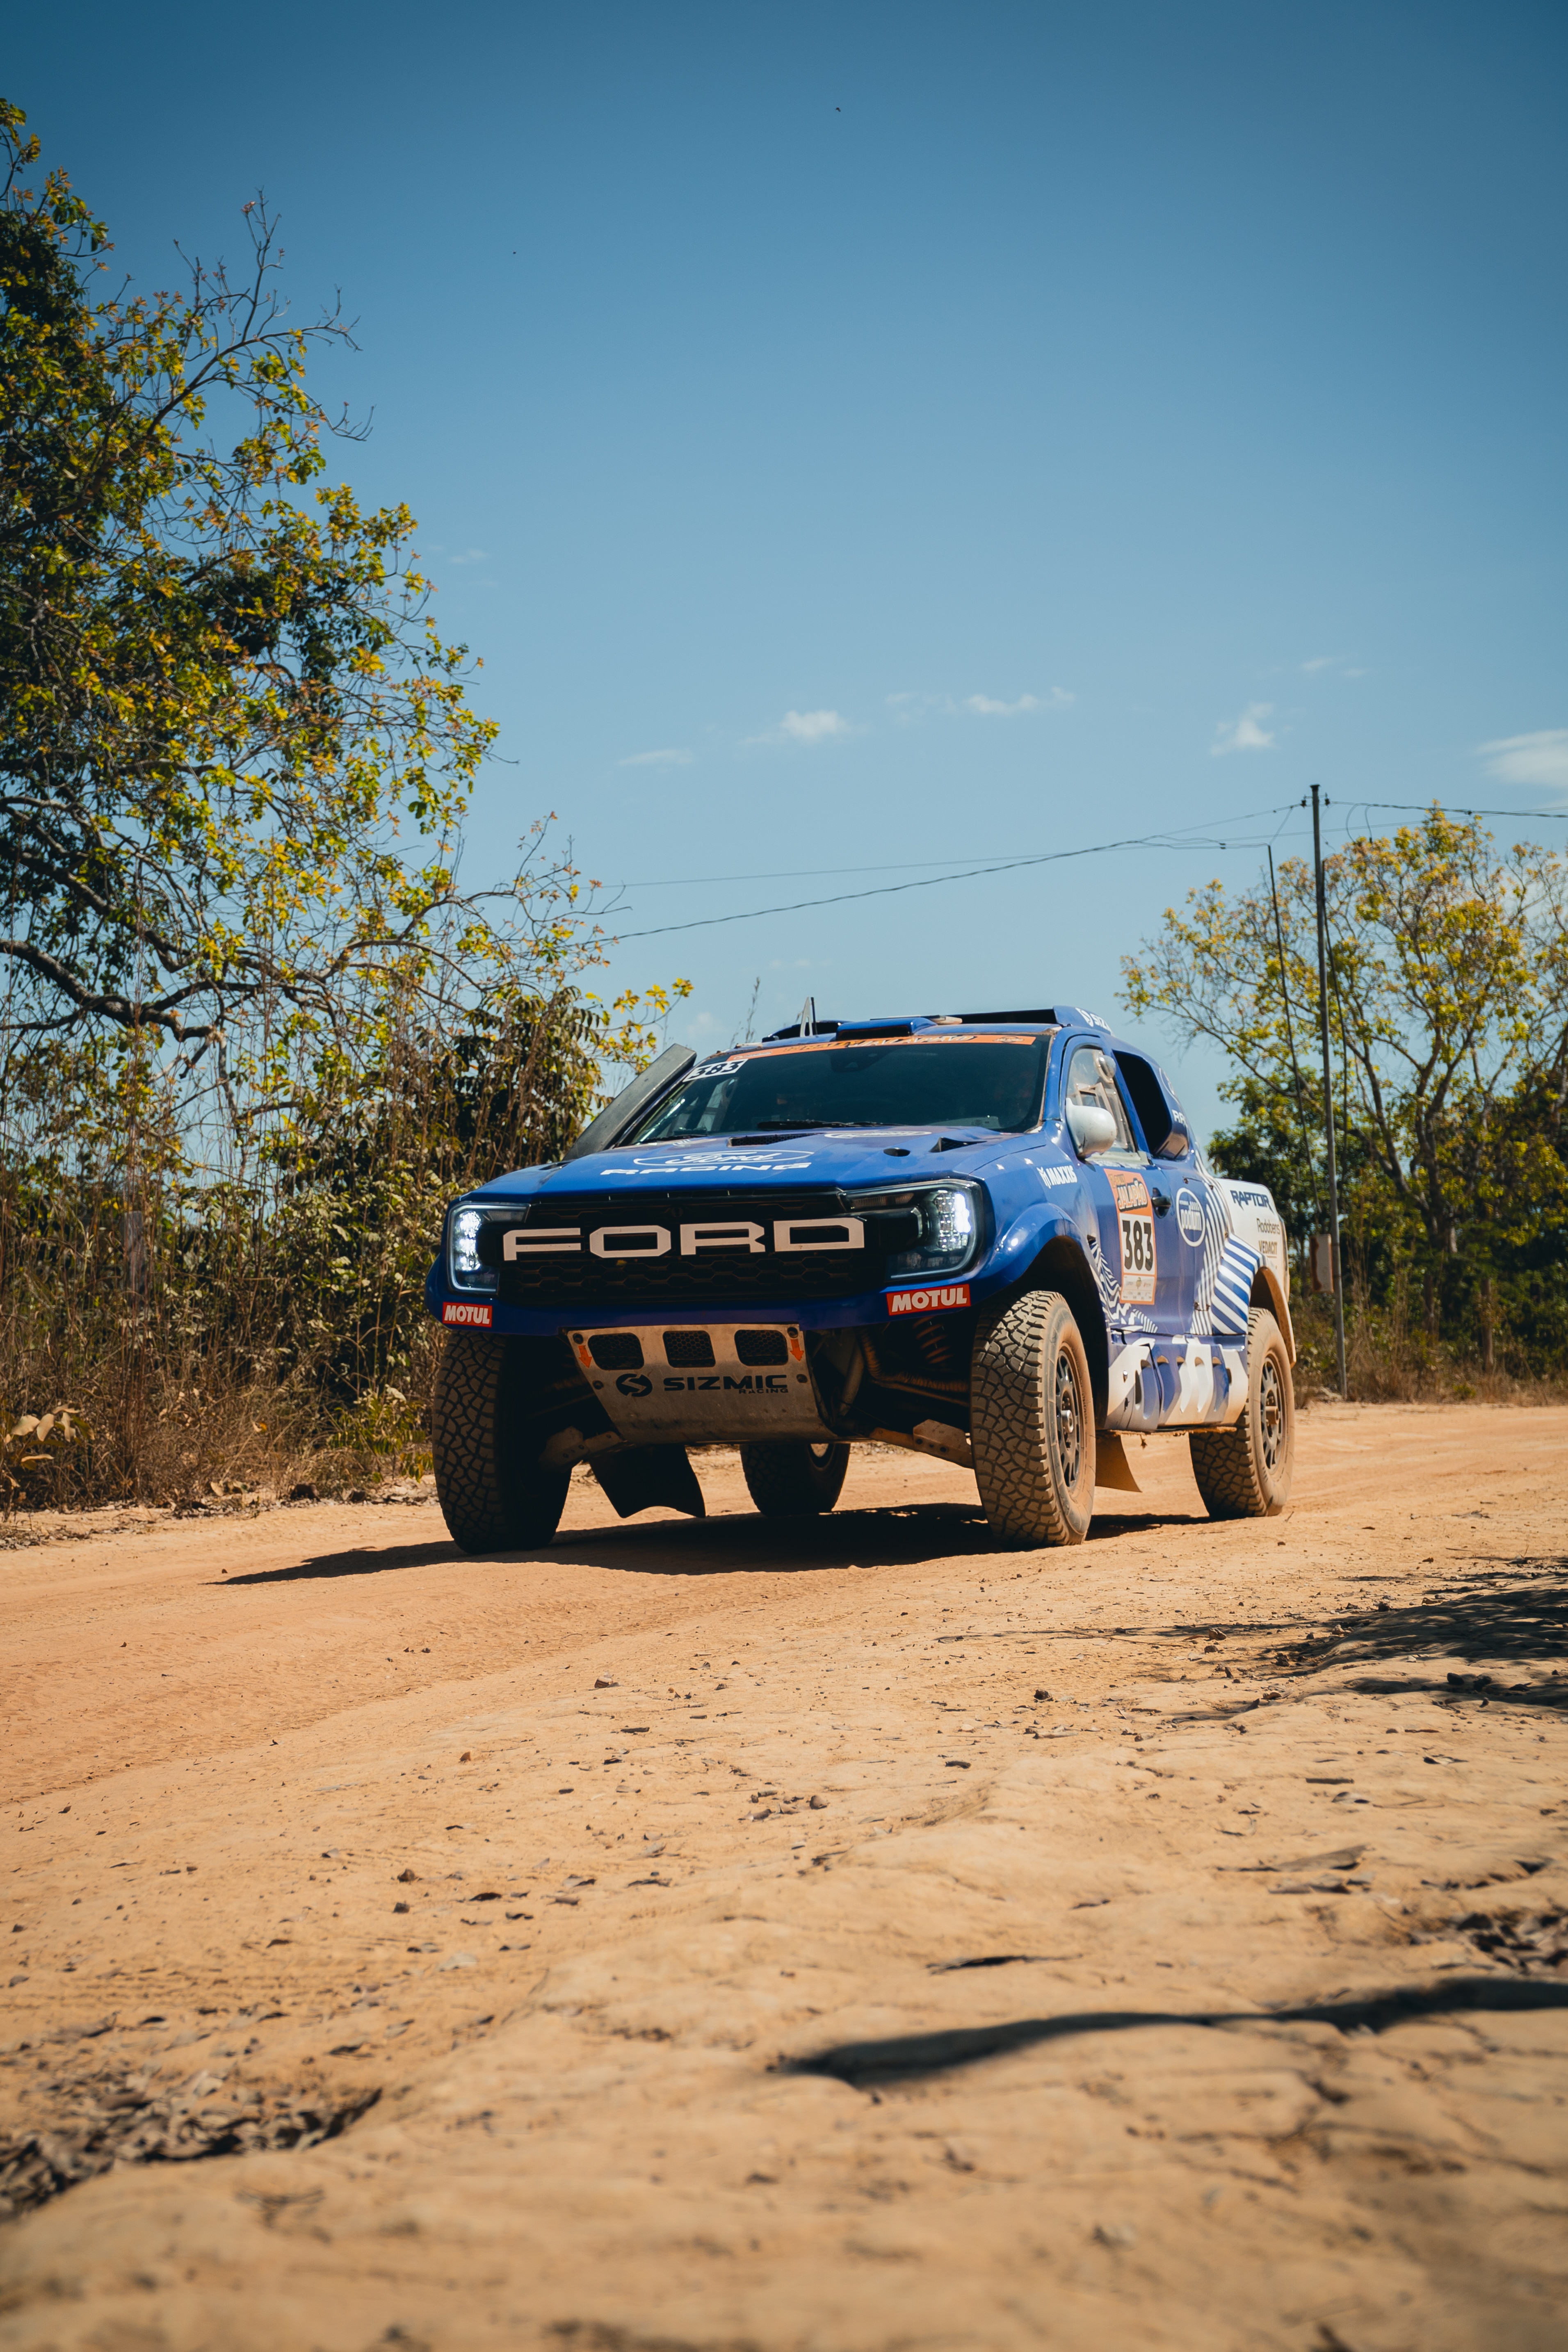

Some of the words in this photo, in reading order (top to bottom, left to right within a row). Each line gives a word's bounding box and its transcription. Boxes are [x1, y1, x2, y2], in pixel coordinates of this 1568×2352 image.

[689, 1061, 745, 1079] 383
[600, 1162, 811, 1175] RACING
[1045, 1165, 1077, 1186] MAXXIS
[1230, 1190, 1275, 1215] RAPTOR
[503, 1218, 865, 1261] FORD
[1122, 1219, 1153, 1271] 383
[1259, 1240, 1277, 1255] VEDACIT
[892, 1287, 967, 1312] MOTUL
[444, 1305, 490, 1324] MOTUL
[663, 1375, 787, 1391] SIZMIC
